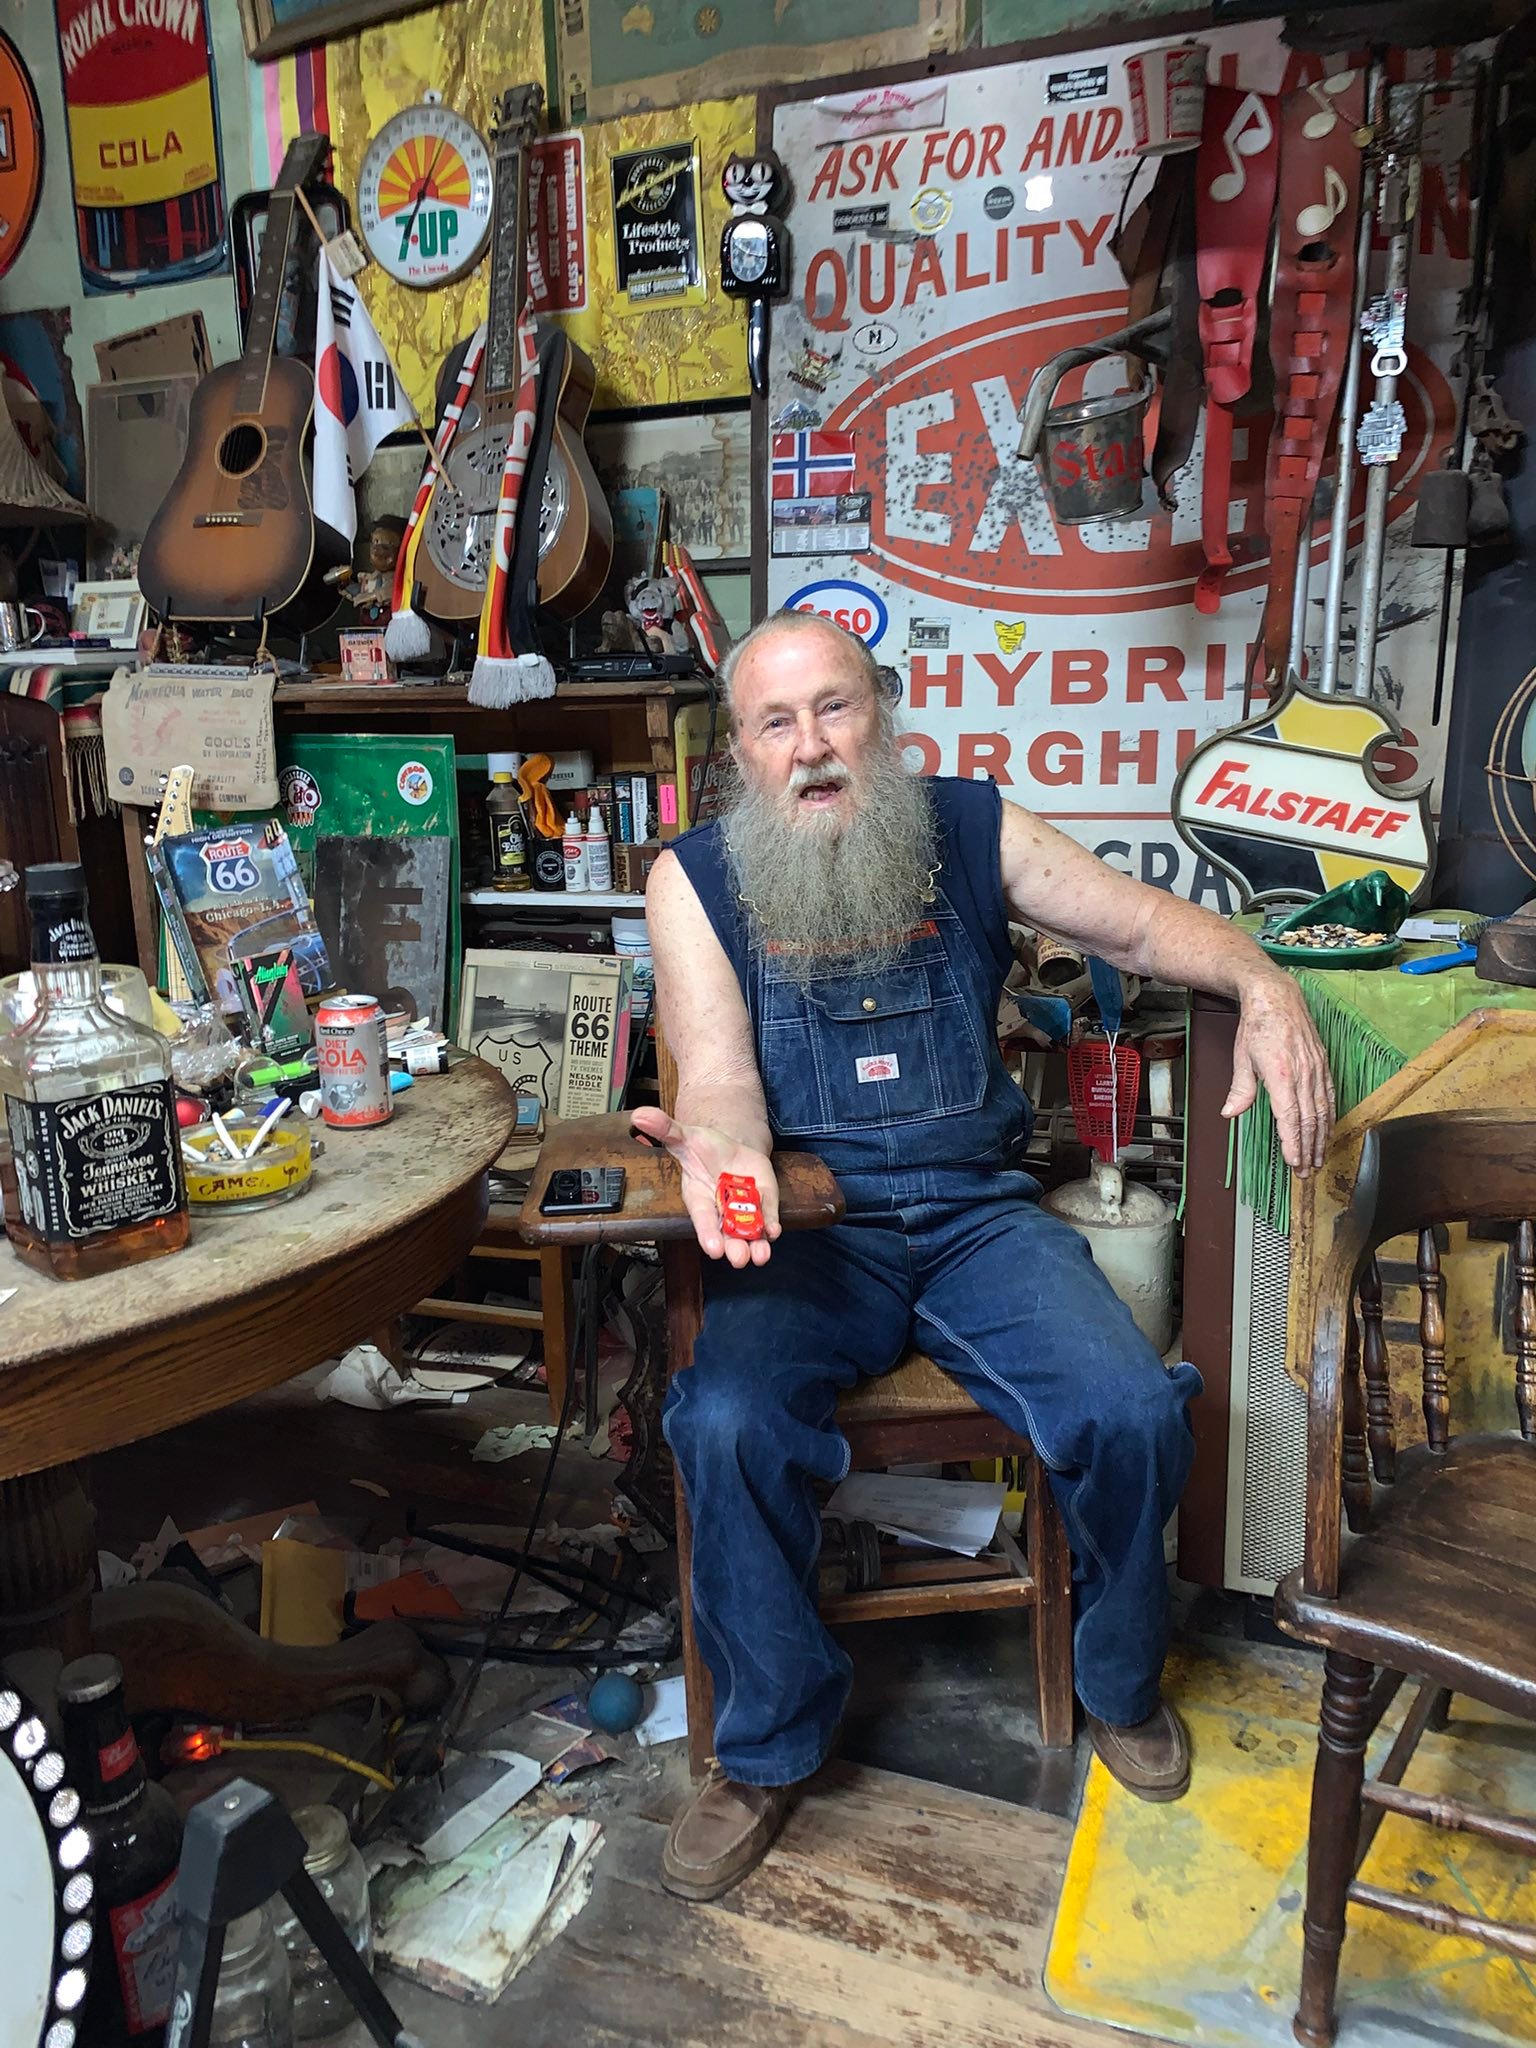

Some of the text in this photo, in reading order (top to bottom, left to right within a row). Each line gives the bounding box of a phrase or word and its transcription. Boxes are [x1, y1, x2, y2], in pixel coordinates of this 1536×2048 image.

[61, 0, 199, 74] ROYAL CROWN
[99, 128, 183, 169] COLA
[808, 139, 908, 203] ASK
[919, 124, 1006, 186] FOR
[623, 219, 681, 240] Lifestyle
[628, 238, 691, 256] Products
[568, 261, 580, 302] CLASS
[805, 214, 1116, 333] QUALITY
[125, 683, 186, 709] MINNEQUA
[192, 687, 222, 699] WATER
[1195, 760, 1412, 839] FALSTAFF
[209, 844, 244, 860] ROUTE
[215, 858, 255, 889] 66
[573, 995, 612, 1013] ROUTE
[331, 1027, 354, 1035] Choice
[571, 1012, 610, 1041] 66
[325, 1039, 348, 1049] DIET
[569, 1040, 609, 1058] THEME
[569, 1072, 603, 1081] NELSON
[579, 1065, 604, 1073] THEMES
[568, 1080, 602, 1088] RIDDLE
[60, 1097, 164, 1139] JACK DANIEL'S
[82, 1153, 154, 1180] Tennessee
[80, 1167, 158, 1198] WHISKEY
